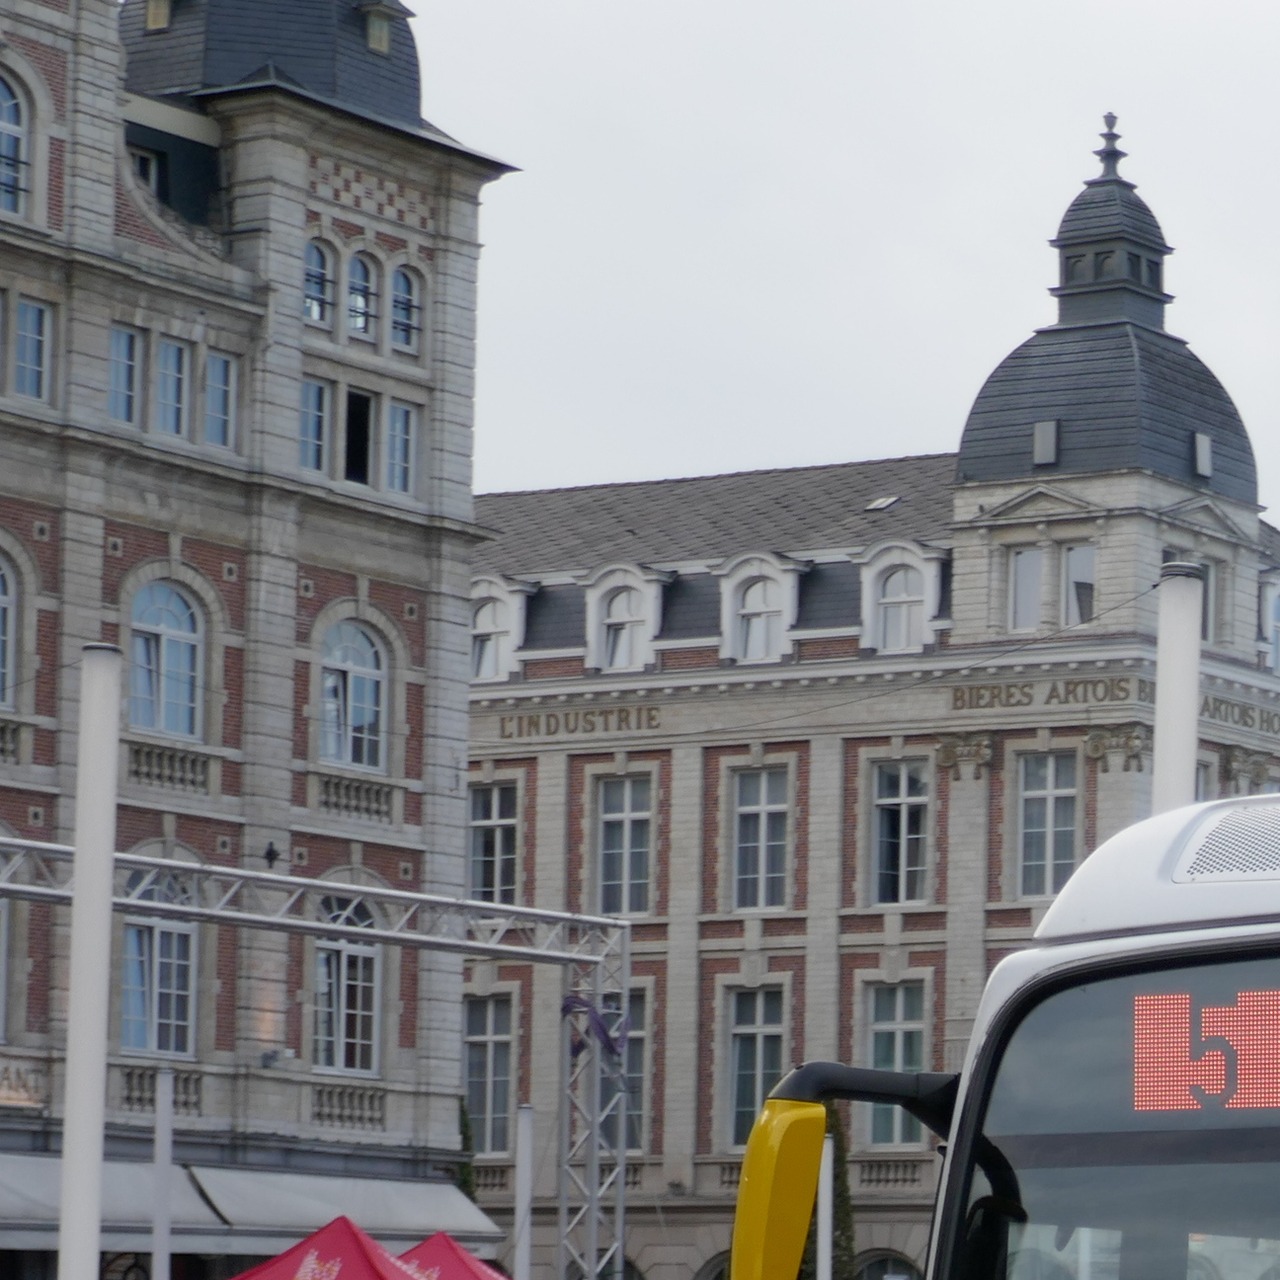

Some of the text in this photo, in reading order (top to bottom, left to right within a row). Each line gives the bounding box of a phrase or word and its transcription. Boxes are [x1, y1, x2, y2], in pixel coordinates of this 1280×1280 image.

[951, 683, 1034, 711] BIERES
[1044, 677, 1131, 705] ARTOIS
[499, 706, 661, 740] L'INDUSTRIE
[1200, 695, 1256, 729] ARTOIS
